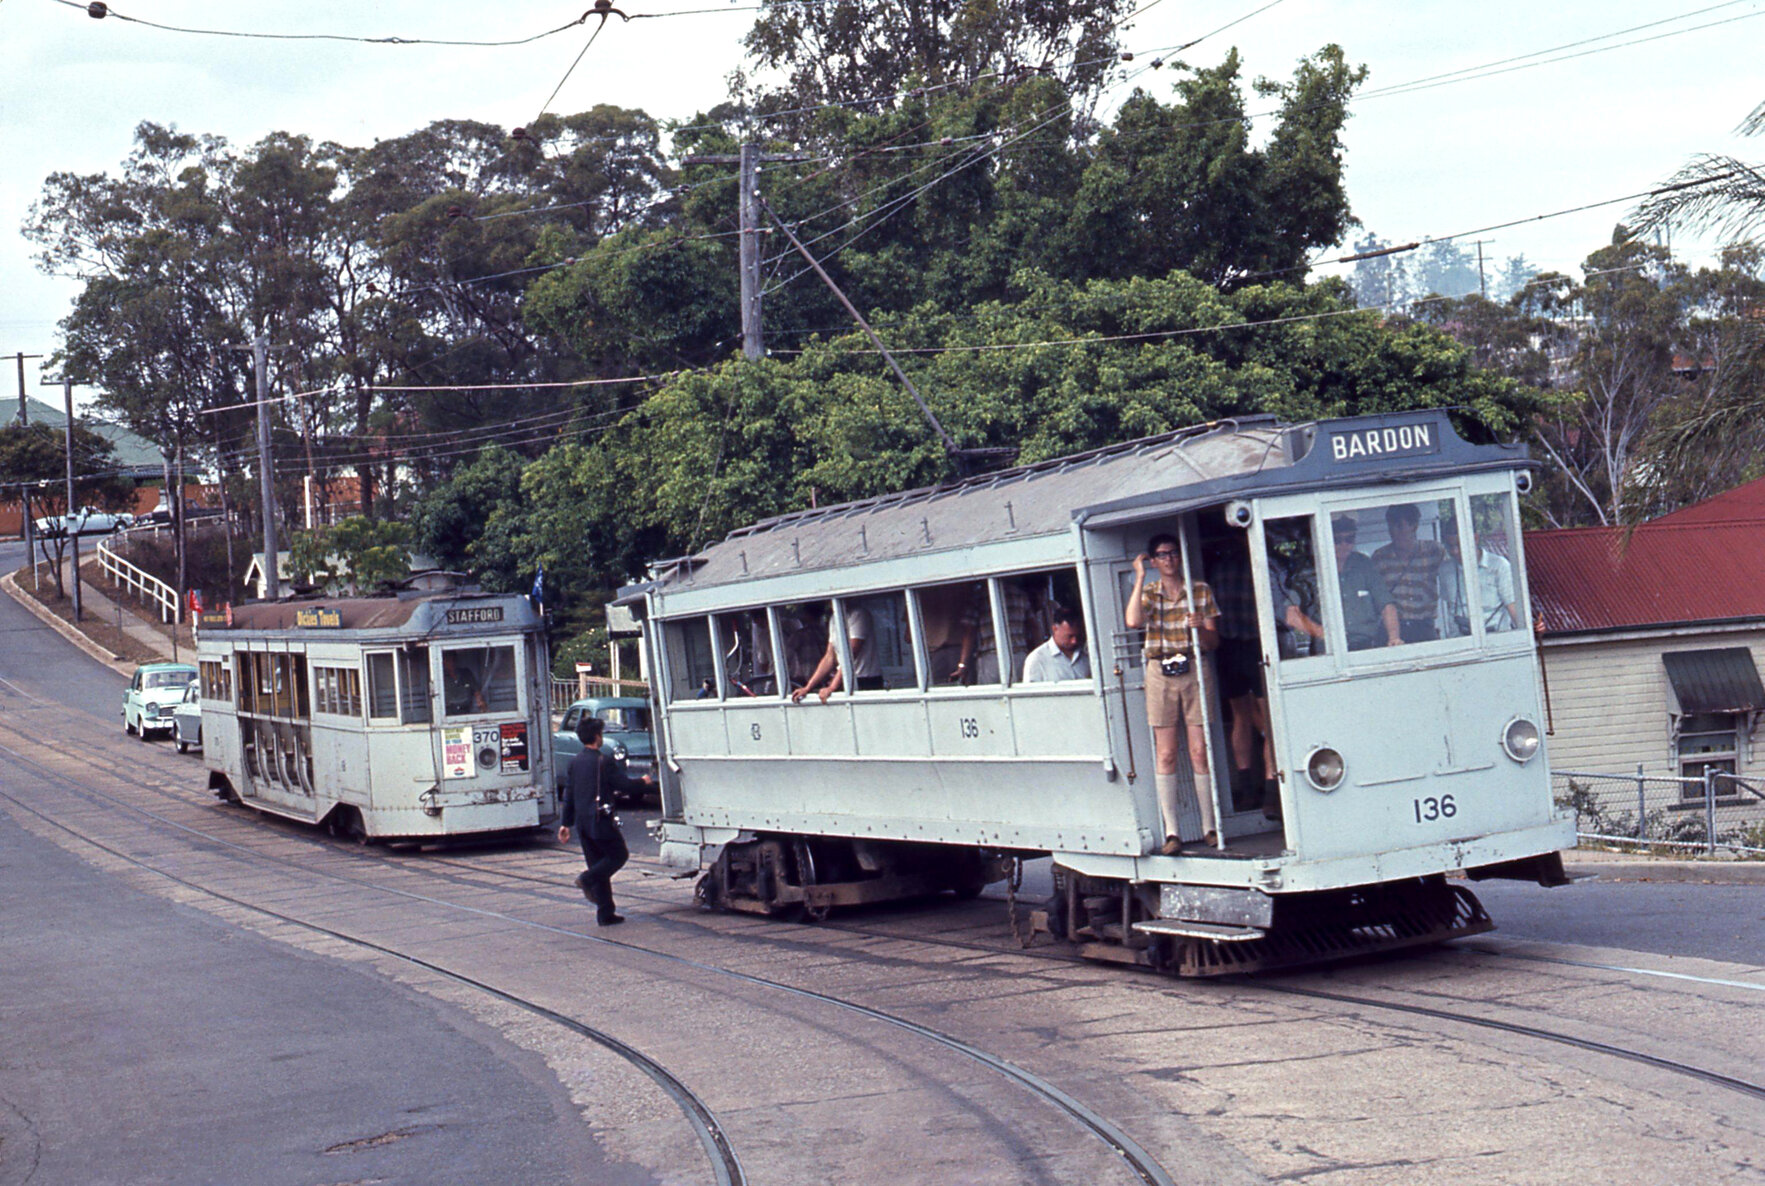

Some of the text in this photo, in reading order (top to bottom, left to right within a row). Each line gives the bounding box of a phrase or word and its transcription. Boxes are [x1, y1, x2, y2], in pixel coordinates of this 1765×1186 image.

[1332, 424, 1431, 460] BARDON
[447, 608, 501, 623] STAFFORD
[960, 718, 979, 738] 136
[473, 731, 499, 744] 370
[445, 743, 471, 754] MONEY
[446, 753, 467, 765] BACK
[1414, 794, 1457, 824] 136
